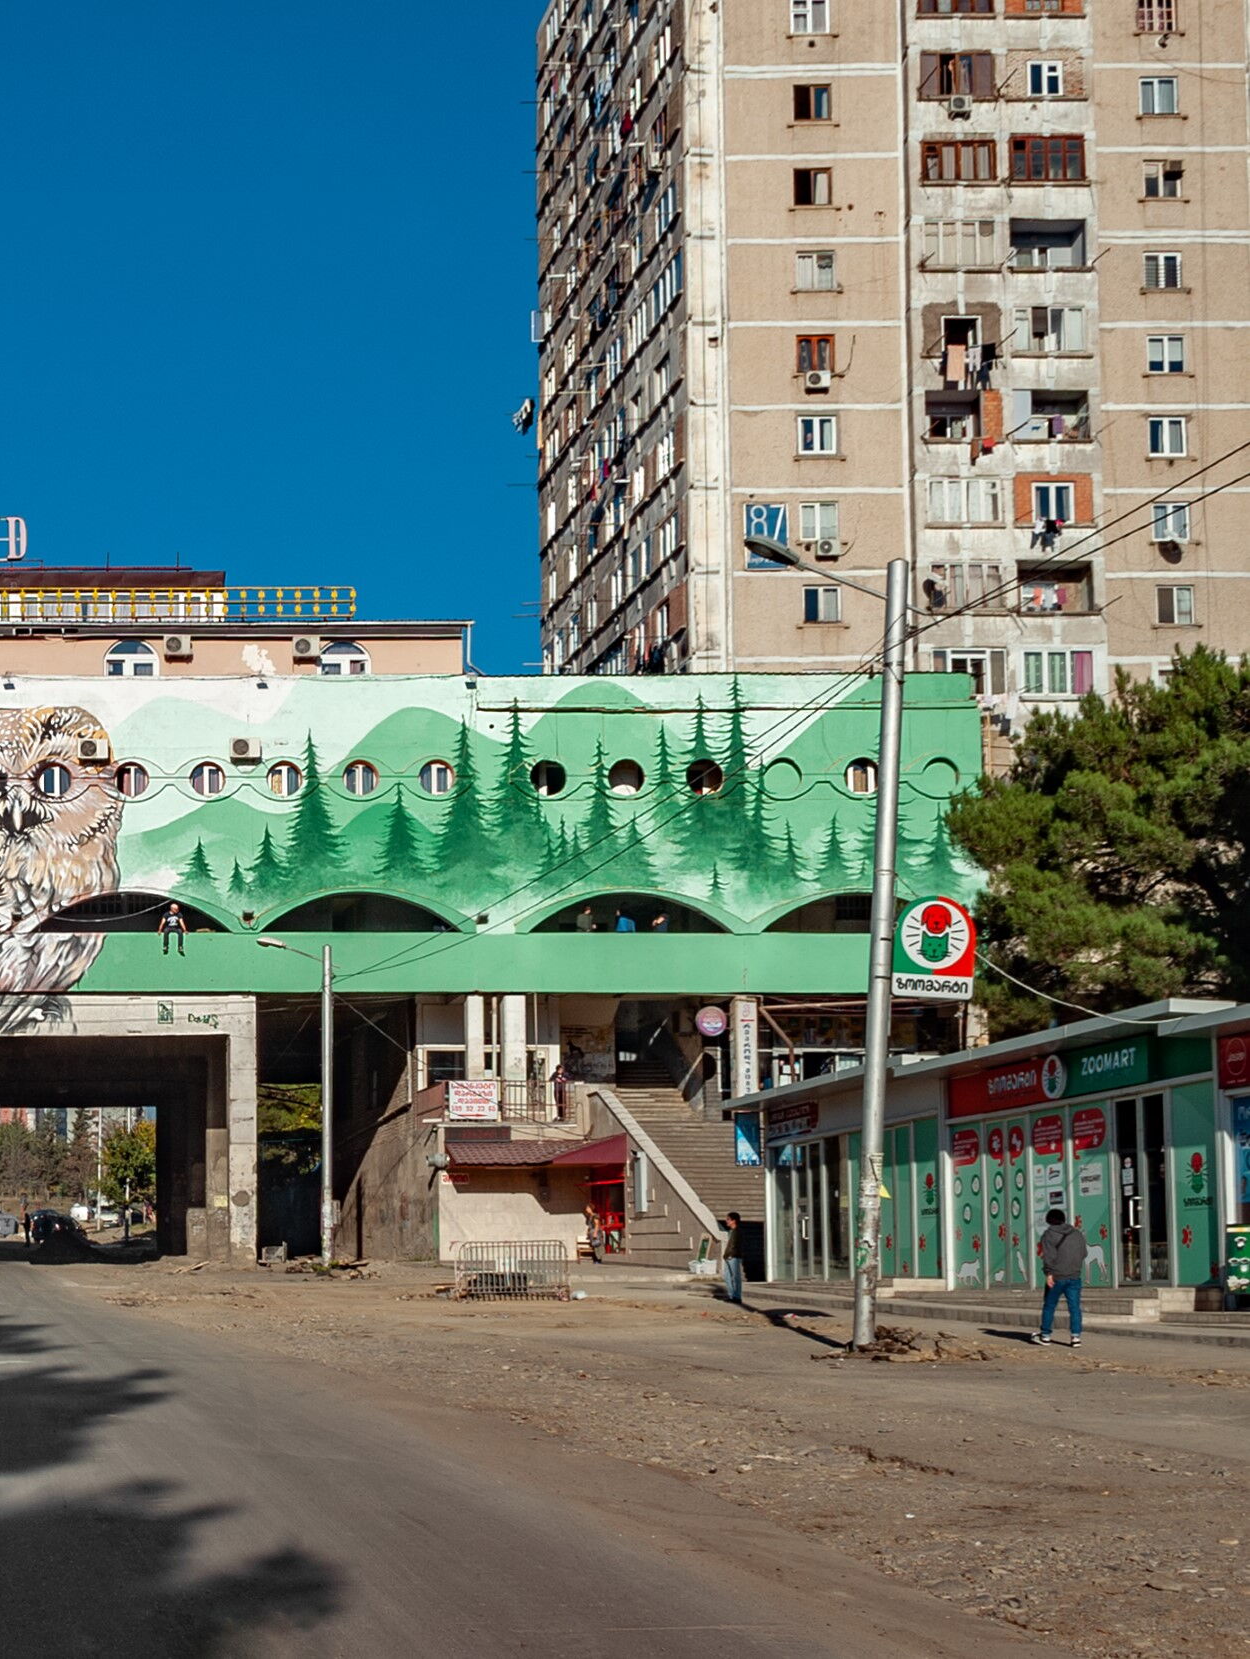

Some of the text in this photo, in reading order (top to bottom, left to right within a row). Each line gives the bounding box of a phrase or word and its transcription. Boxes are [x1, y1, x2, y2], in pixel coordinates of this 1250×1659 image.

[751, 504, 785, 541] 87
[896, 977, 969, 994] ზოომარტი
[1081, 1047, 1136, 1076] ZOOMART
